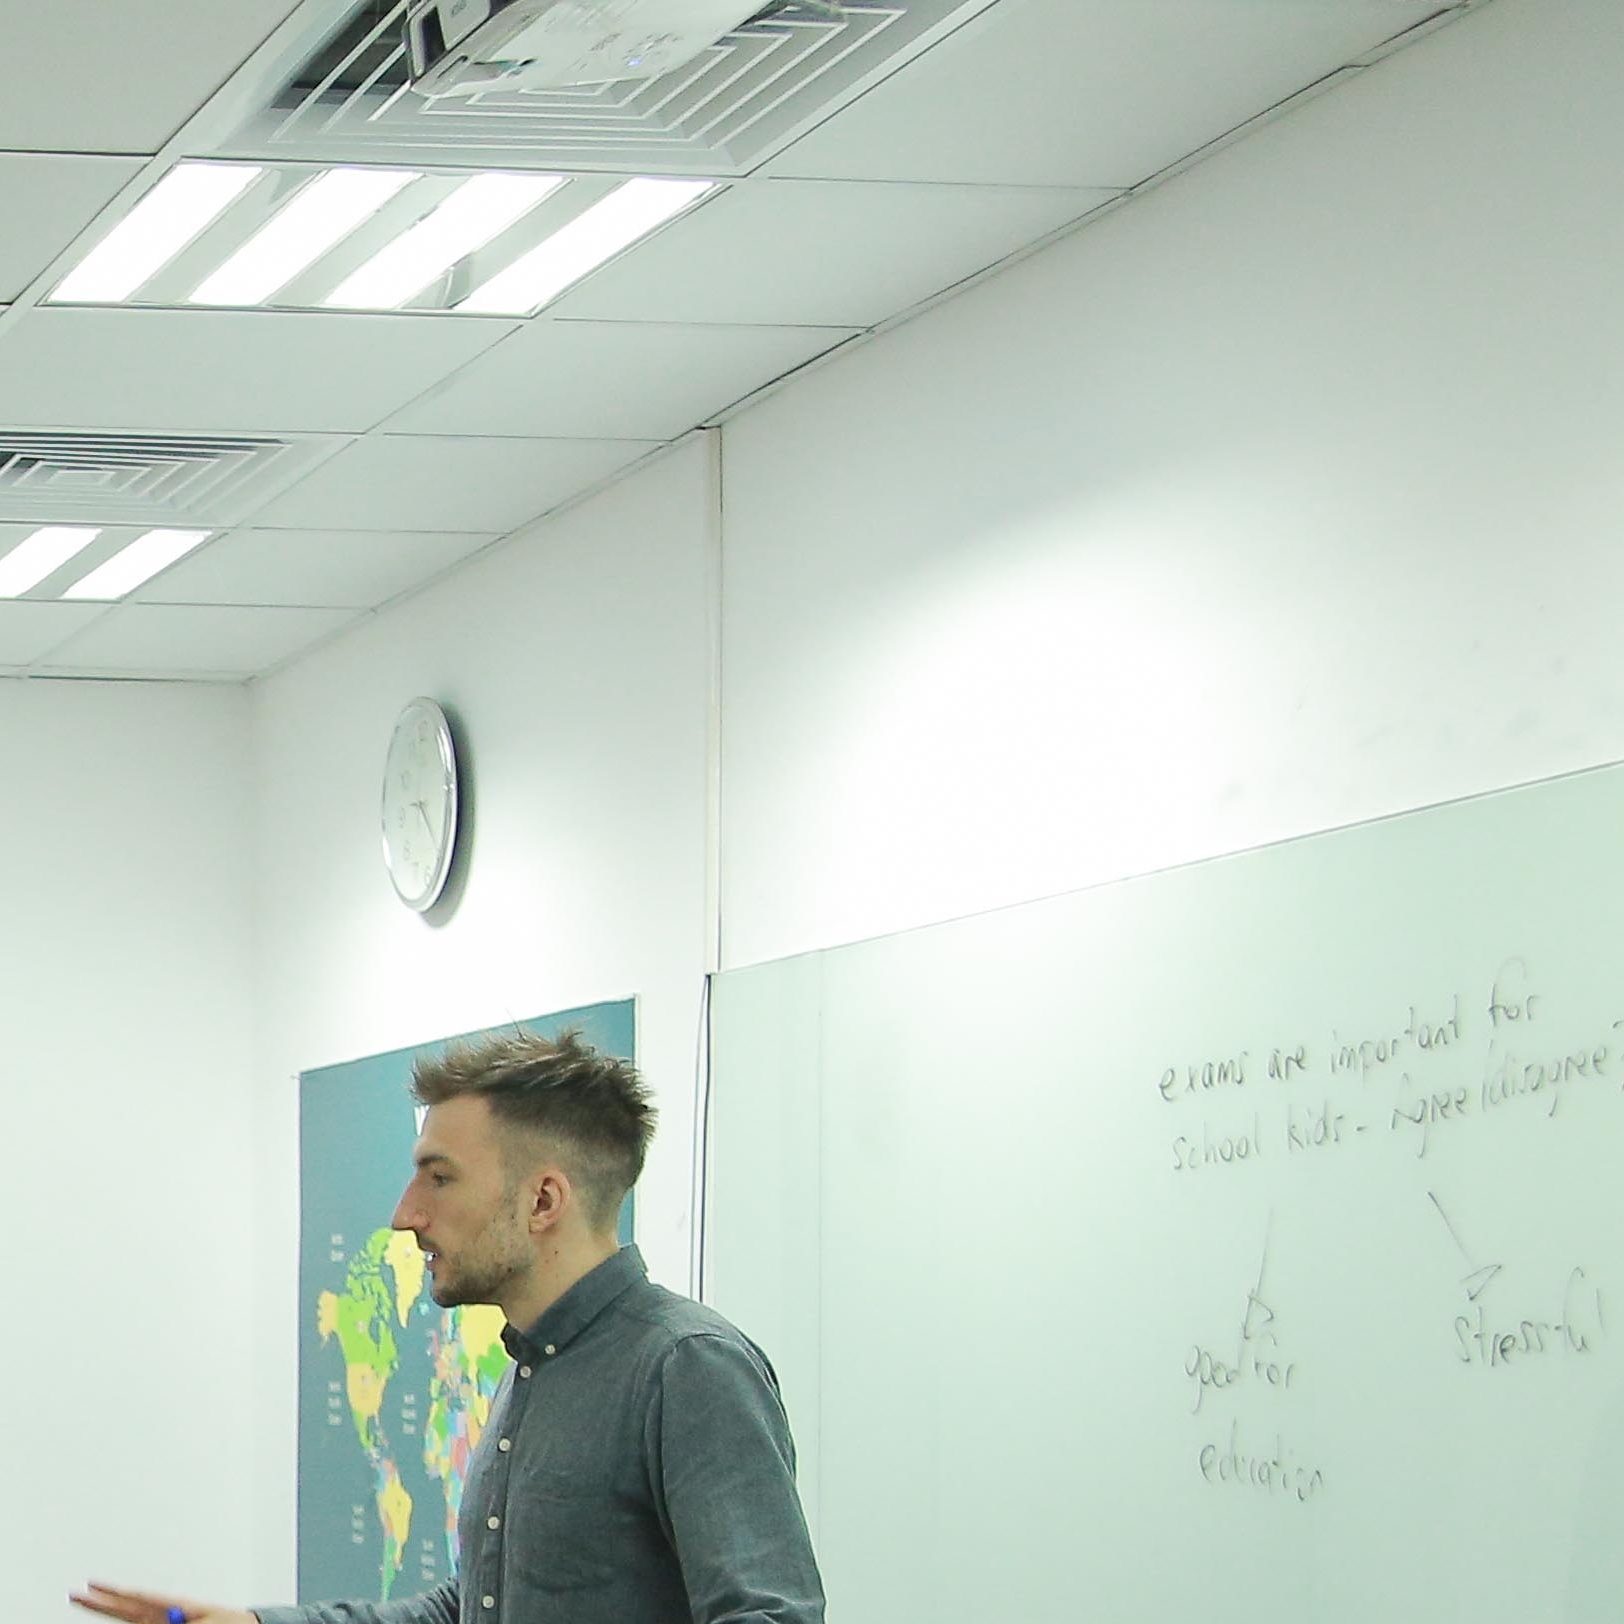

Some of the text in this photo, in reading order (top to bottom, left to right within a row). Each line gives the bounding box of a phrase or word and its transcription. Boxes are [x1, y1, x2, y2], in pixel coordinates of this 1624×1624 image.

[1158, 957, 1541, 1102] exams are important for
